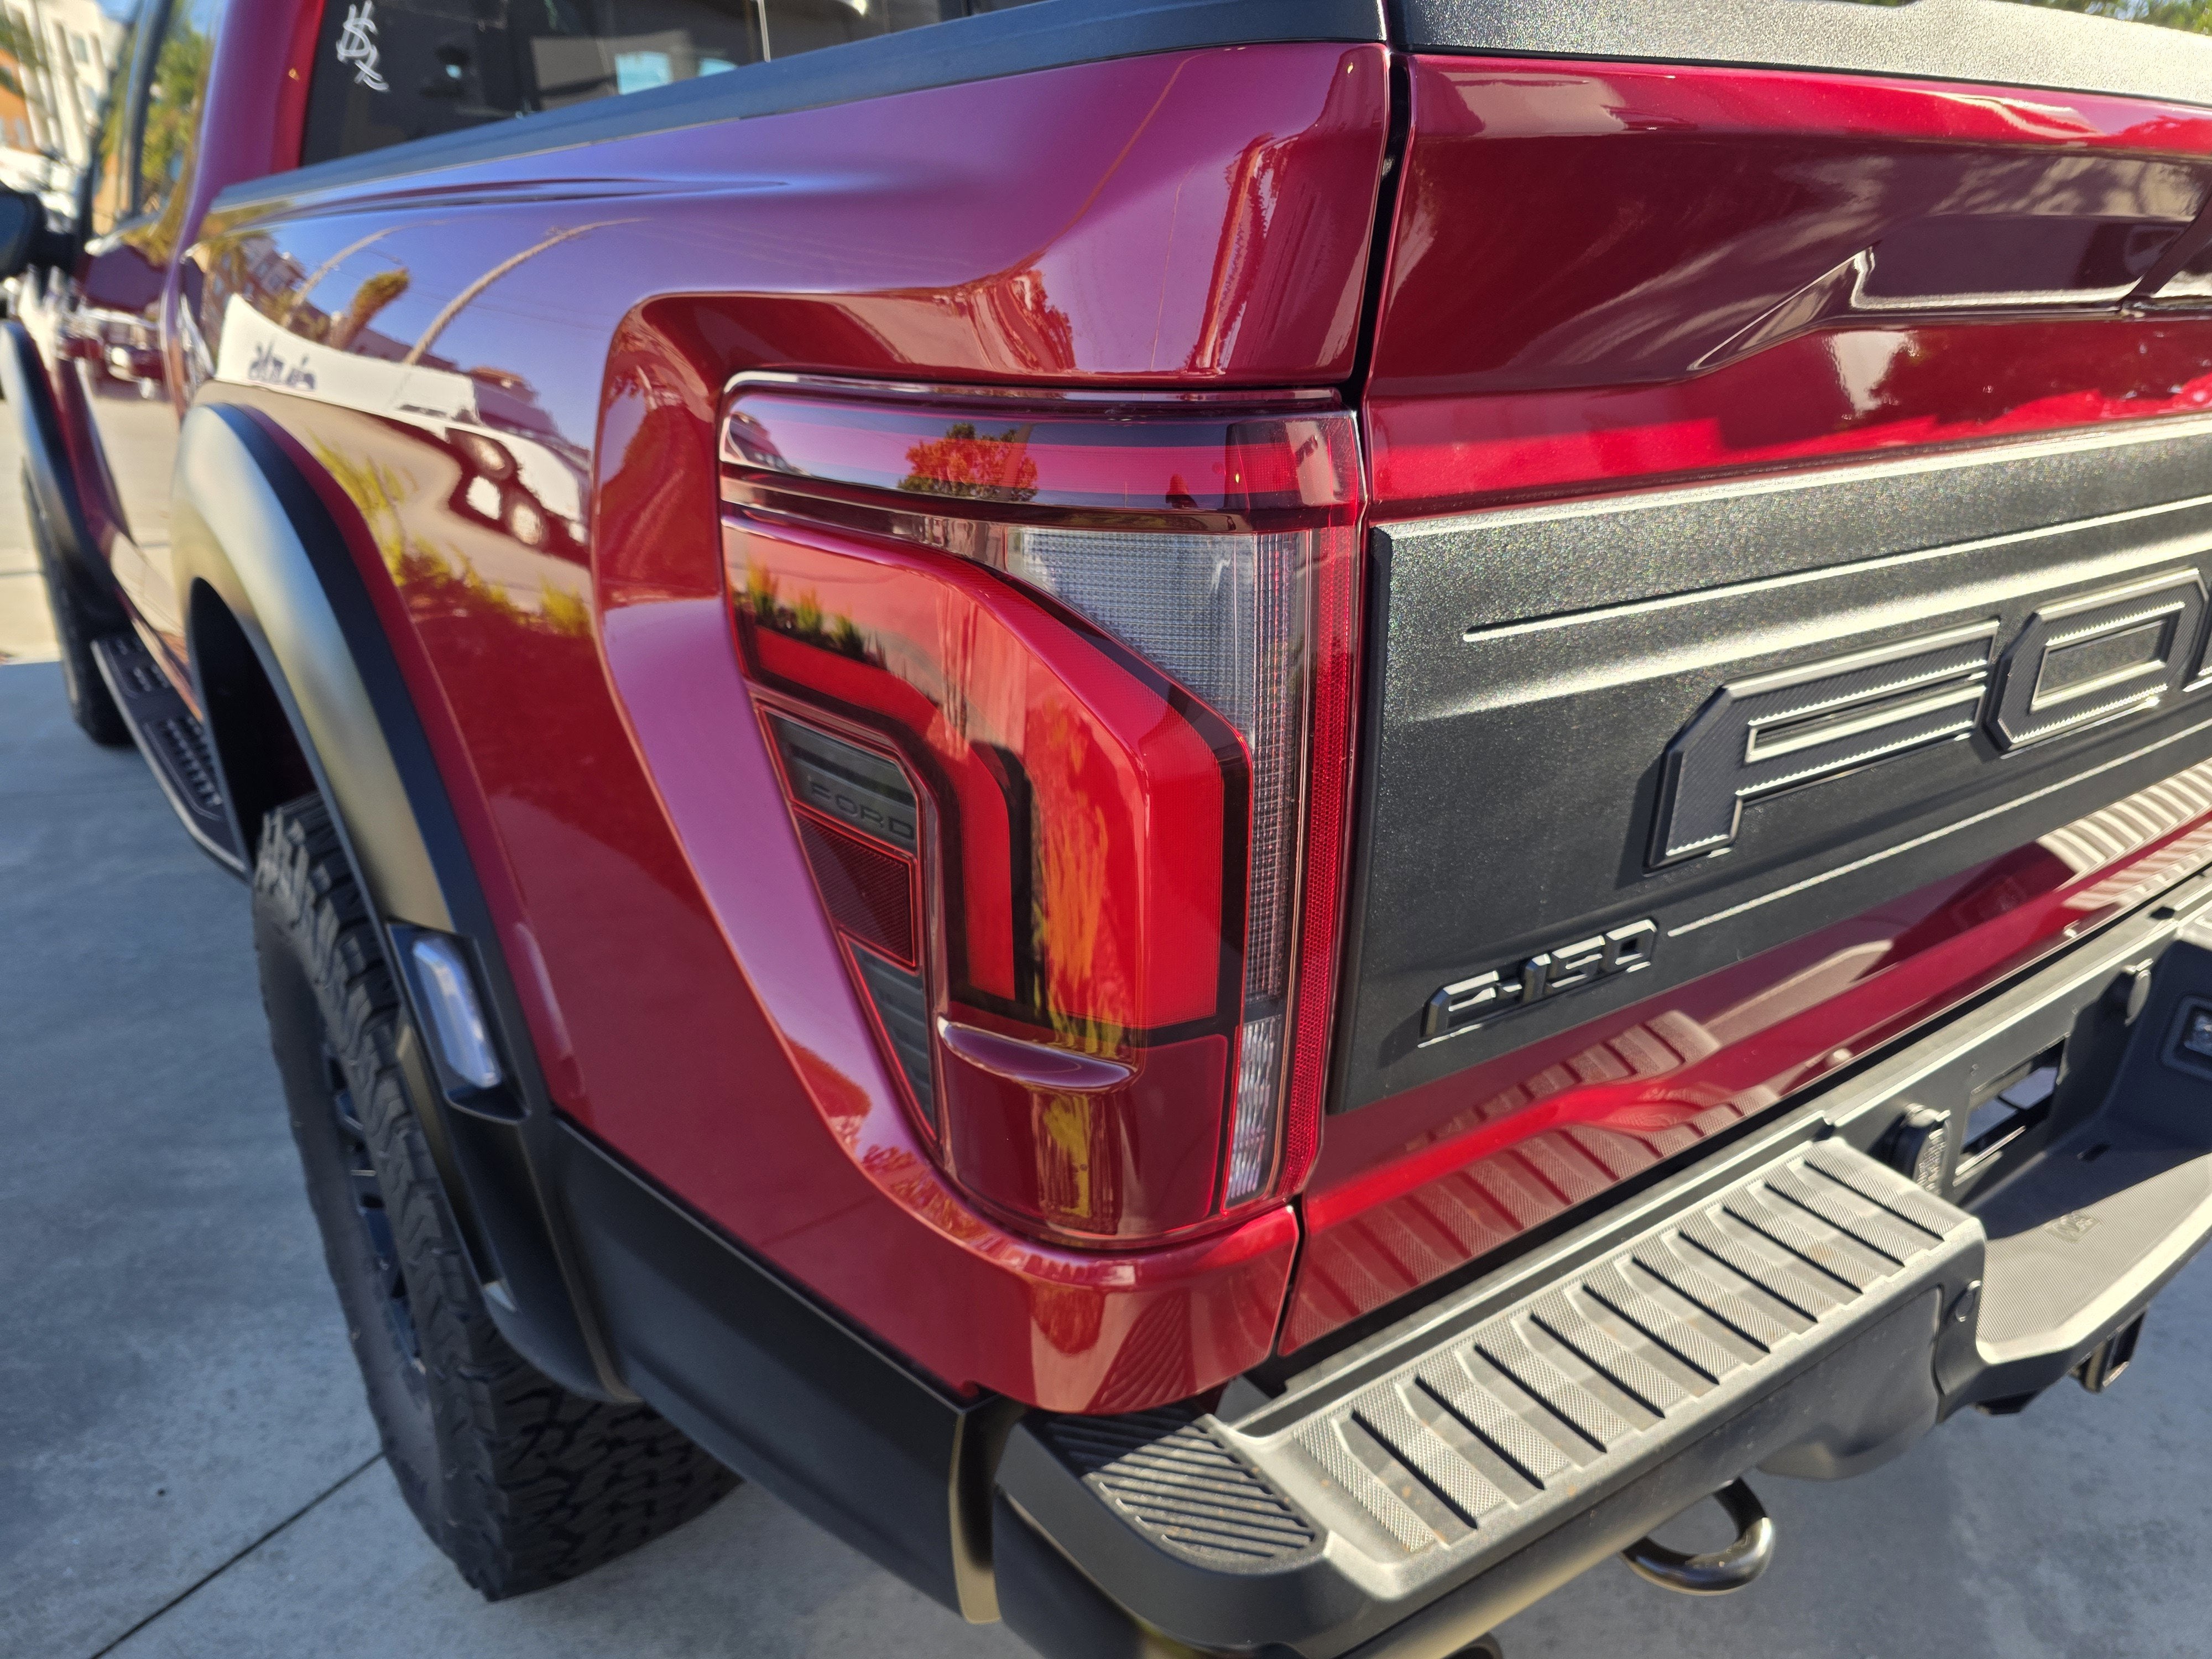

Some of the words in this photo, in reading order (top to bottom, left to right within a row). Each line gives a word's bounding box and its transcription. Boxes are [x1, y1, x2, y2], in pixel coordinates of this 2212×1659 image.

[1644, 567, 2212, 873] FO
[808, 781, 914, 840] FORD
[1419, 919, 1658, 1044] F-150
